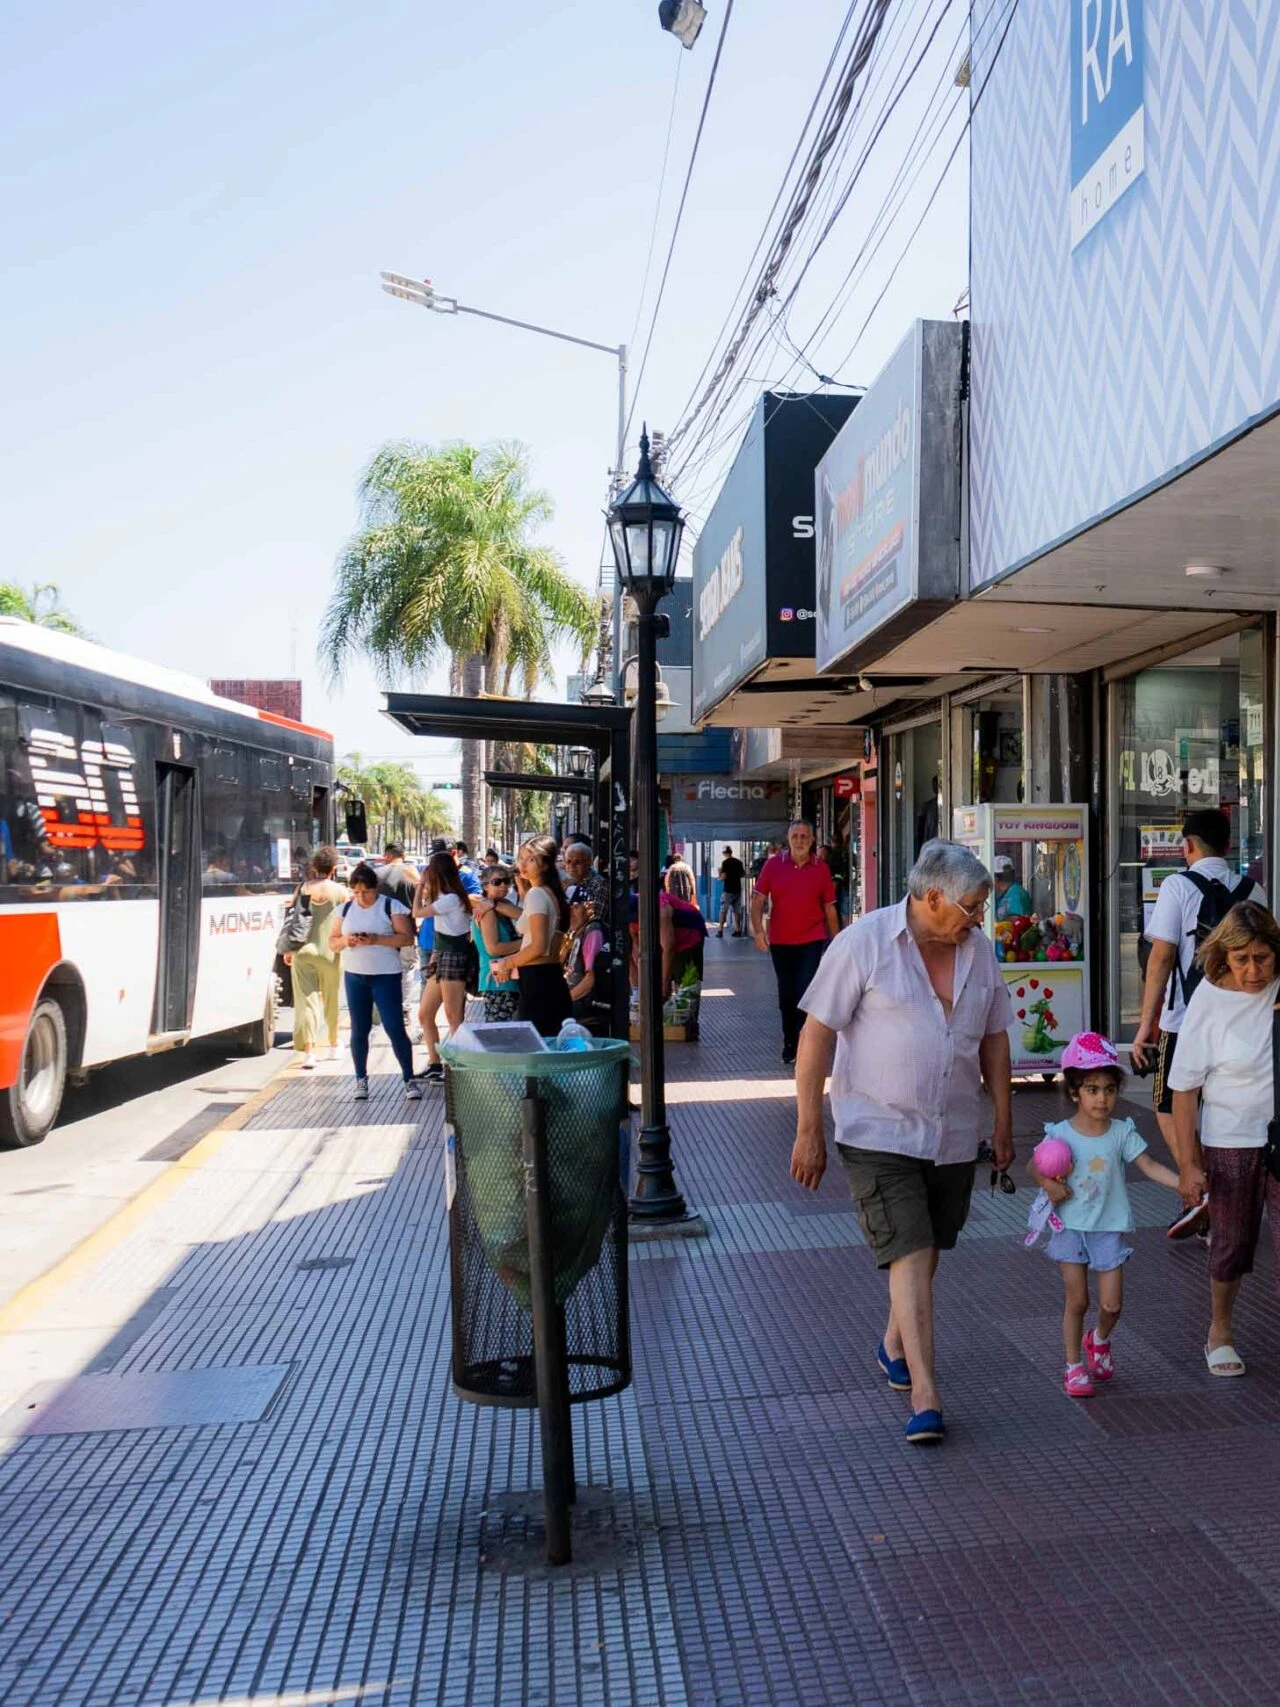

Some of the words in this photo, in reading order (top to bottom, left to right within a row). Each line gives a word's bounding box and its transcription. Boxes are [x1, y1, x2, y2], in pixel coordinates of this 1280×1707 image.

[1080, 145, 1132, 226] home
[1023, 822, 1080, 830] KINGDOM
[209, 910, 275, 936] MONSA
